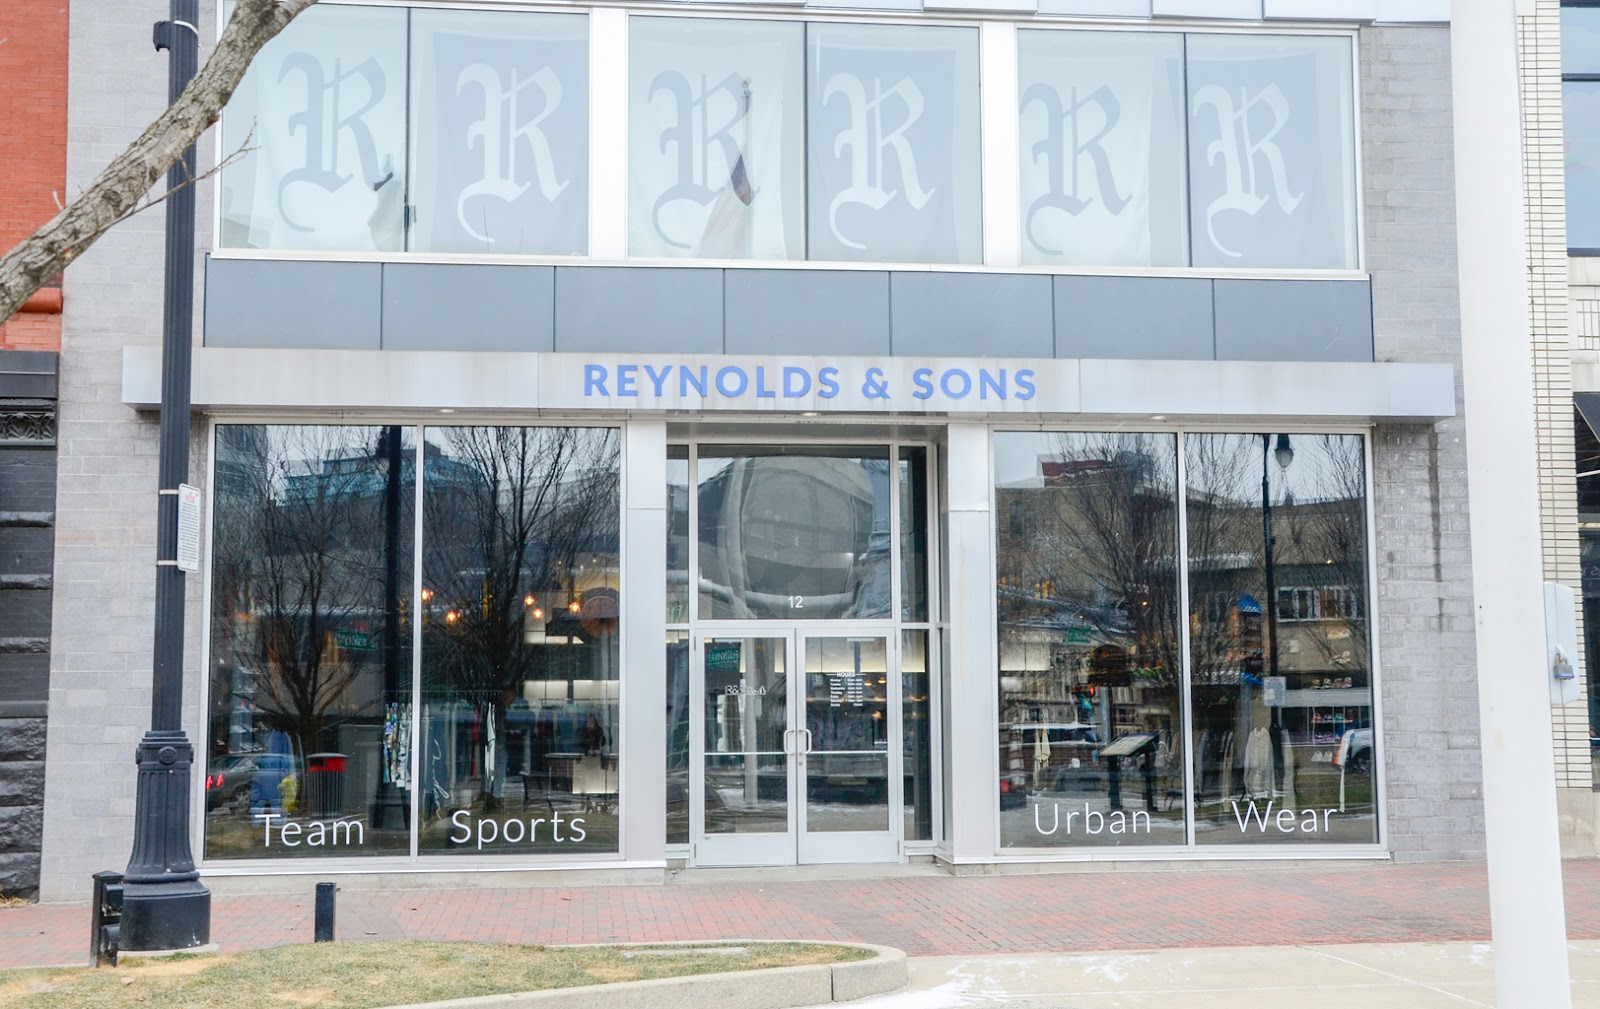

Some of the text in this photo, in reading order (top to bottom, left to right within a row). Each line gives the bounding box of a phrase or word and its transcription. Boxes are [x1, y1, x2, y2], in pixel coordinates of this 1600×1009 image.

[584, 364, 1036, 400] REYNOLDS & SONS
[788, 595, 804, 608] 12
[255, 810, 587, 850] Team Sports
[1034, 800, 1338, 835] Urban Wear
